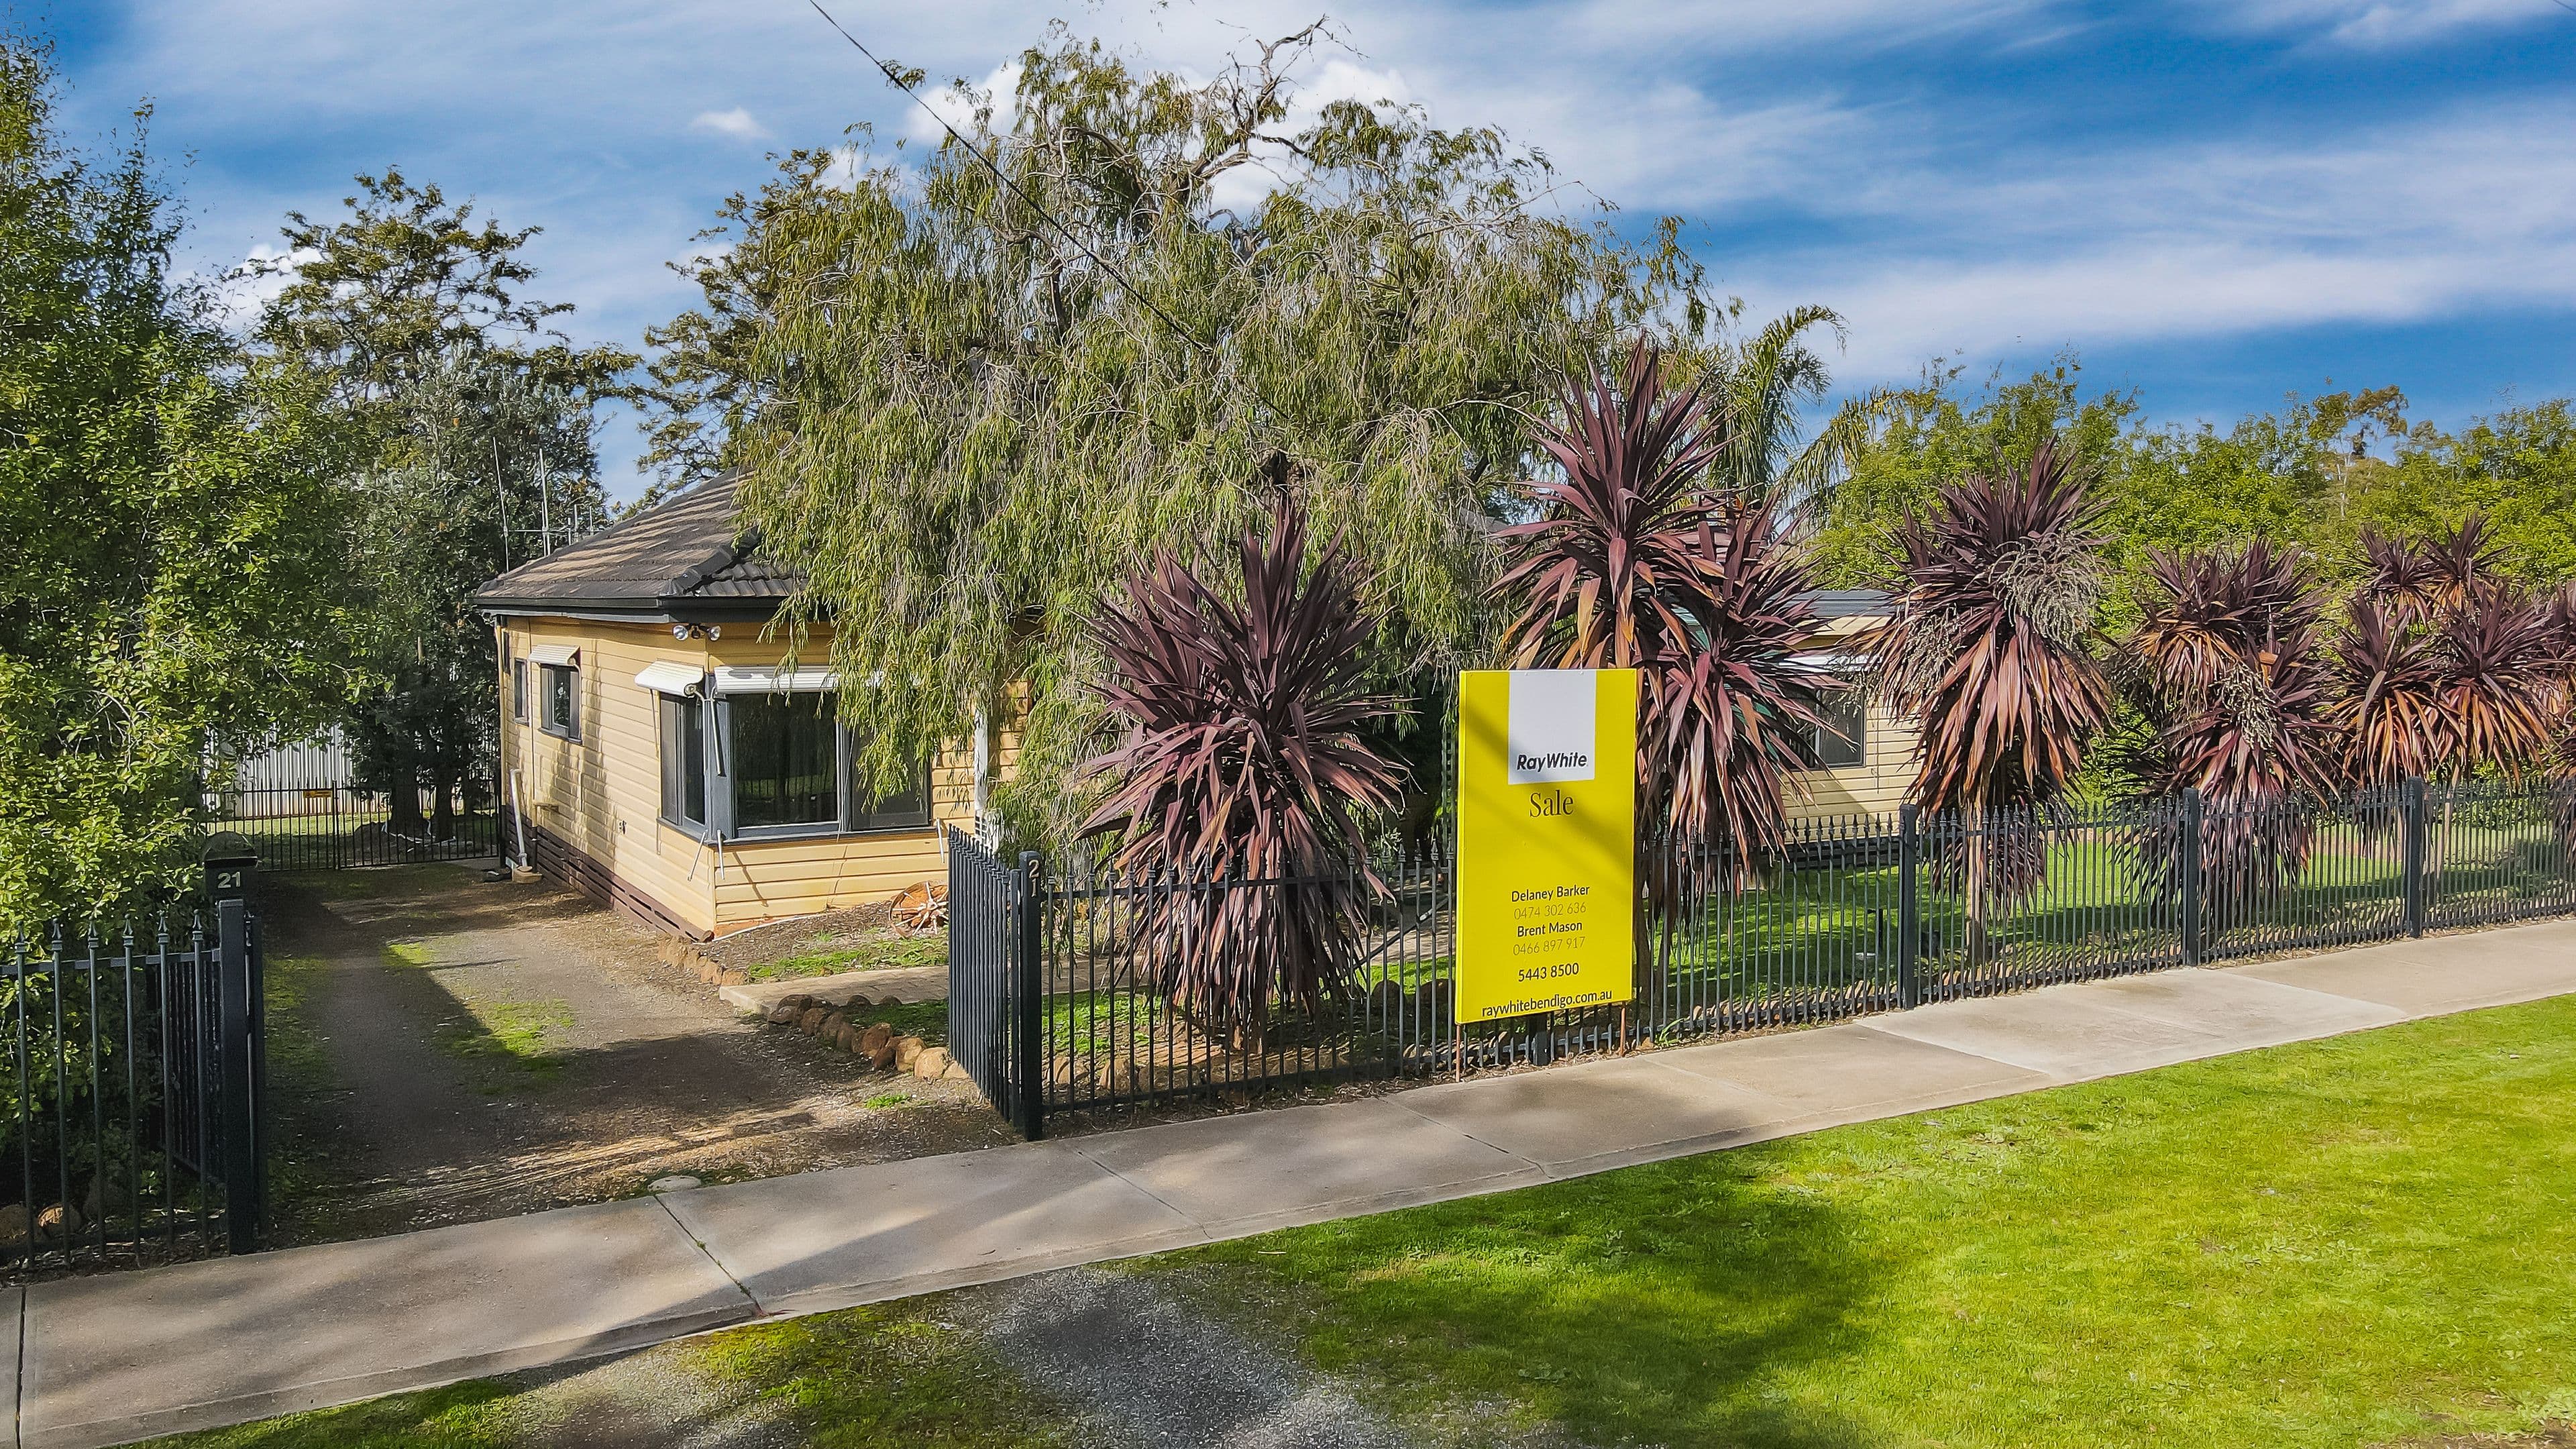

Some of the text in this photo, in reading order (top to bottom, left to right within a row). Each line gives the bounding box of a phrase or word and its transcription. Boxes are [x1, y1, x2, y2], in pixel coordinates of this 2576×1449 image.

[1529, 789, 1574, 817] Sale
[218, 872, 240, 888] 21
[1511, 884, 1590, 902] Delaney Barker
[1514, 902, 1587, 920] 0474 302 636
[1517, 921, 1582, 937] Brent Mason
[1513, 936, 1585, 956] 0466 897 917
[1518, 963, 1579, 982] 5443 8500
[1482, 990, 1612, 1017] raywhitebendigo.com.au
